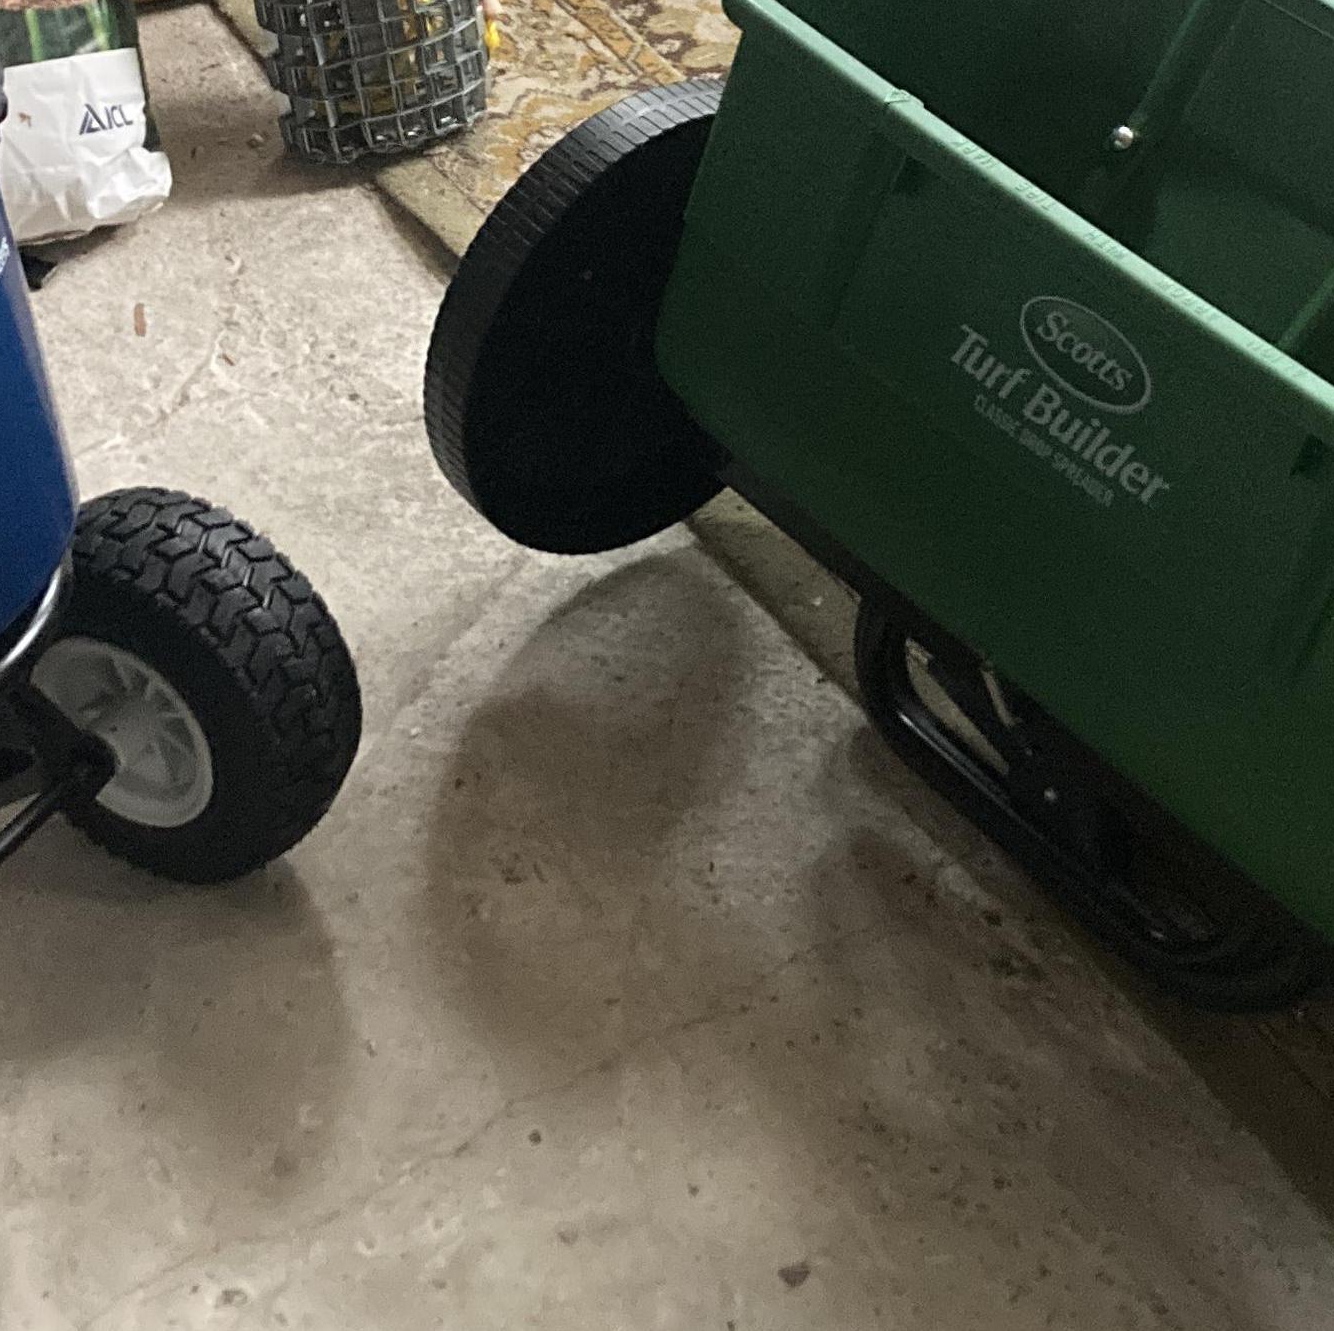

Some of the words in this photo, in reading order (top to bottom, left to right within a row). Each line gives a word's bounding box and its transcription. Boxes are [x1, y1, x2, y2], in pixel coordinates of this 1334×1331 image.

[950, 323, 1032, 400] Turf
[1022, 382, 1171, 506] Builder
[1035, 310, 1134, 392] Scotts
